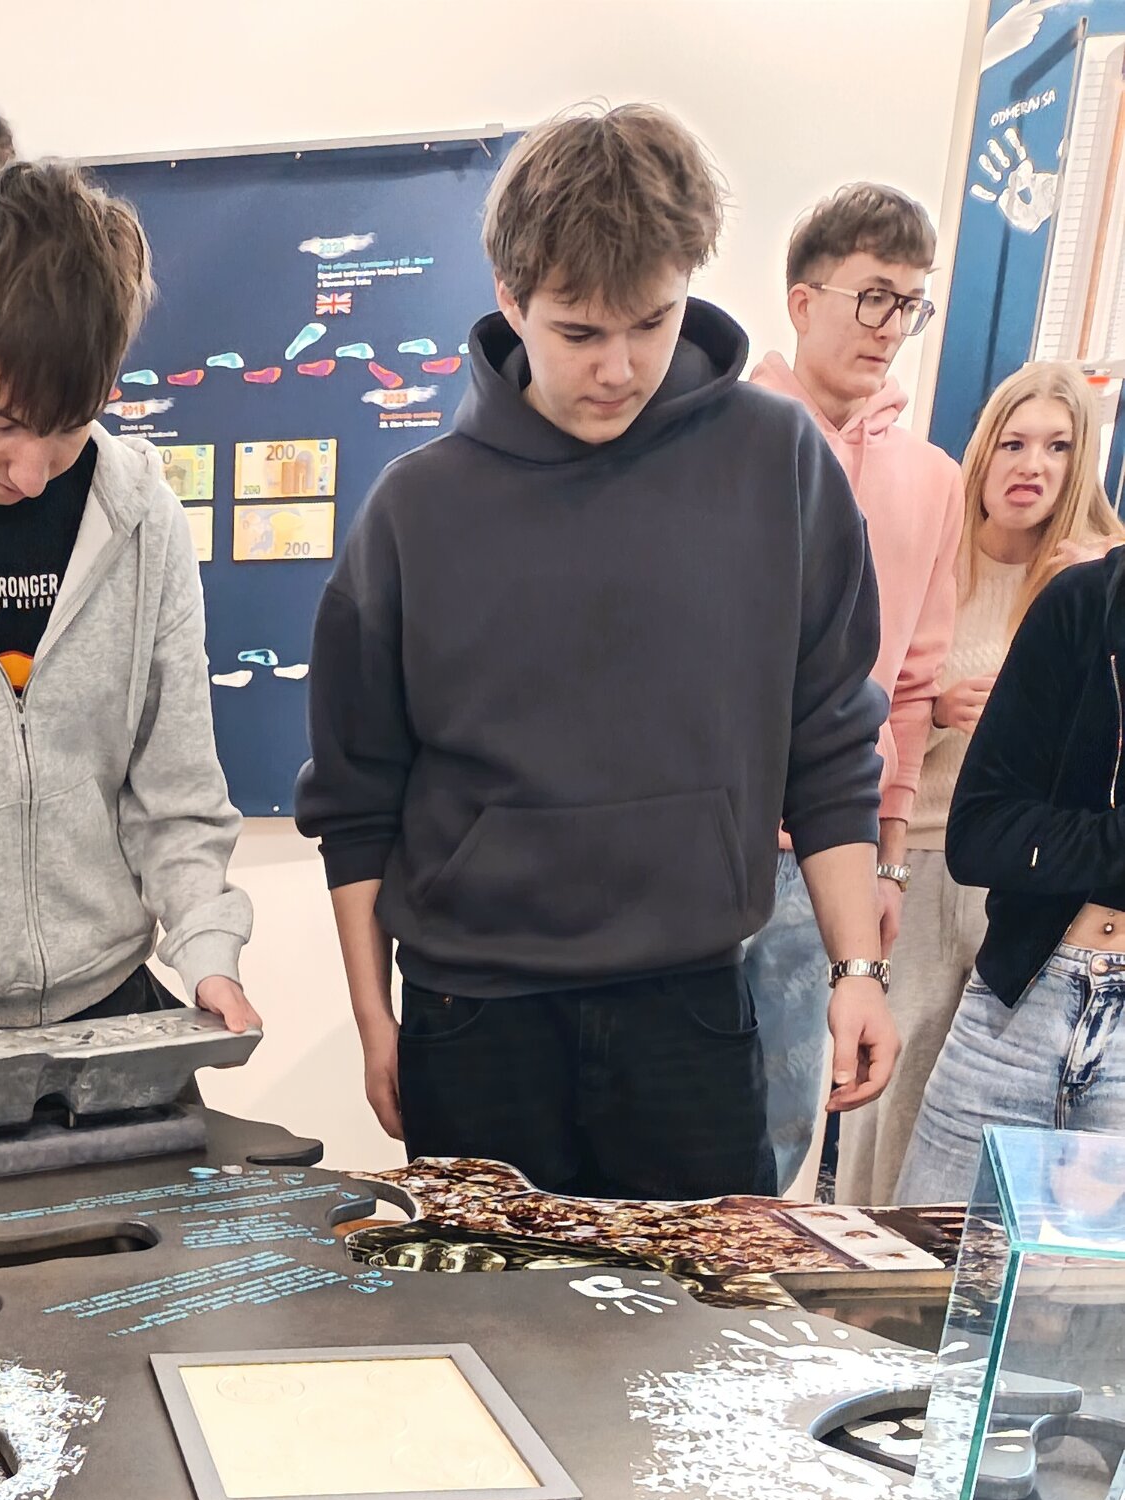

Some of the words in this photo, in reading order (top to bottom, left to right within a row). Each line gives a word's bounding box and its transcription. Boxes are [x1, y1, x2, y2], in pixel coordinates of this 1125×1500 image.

[1042, 88, 1056, 106] SA
[266, 444, 295, 462] 200
[284, 542, 310, 556] 200
[16, 596, 56, 609] BEFOR
